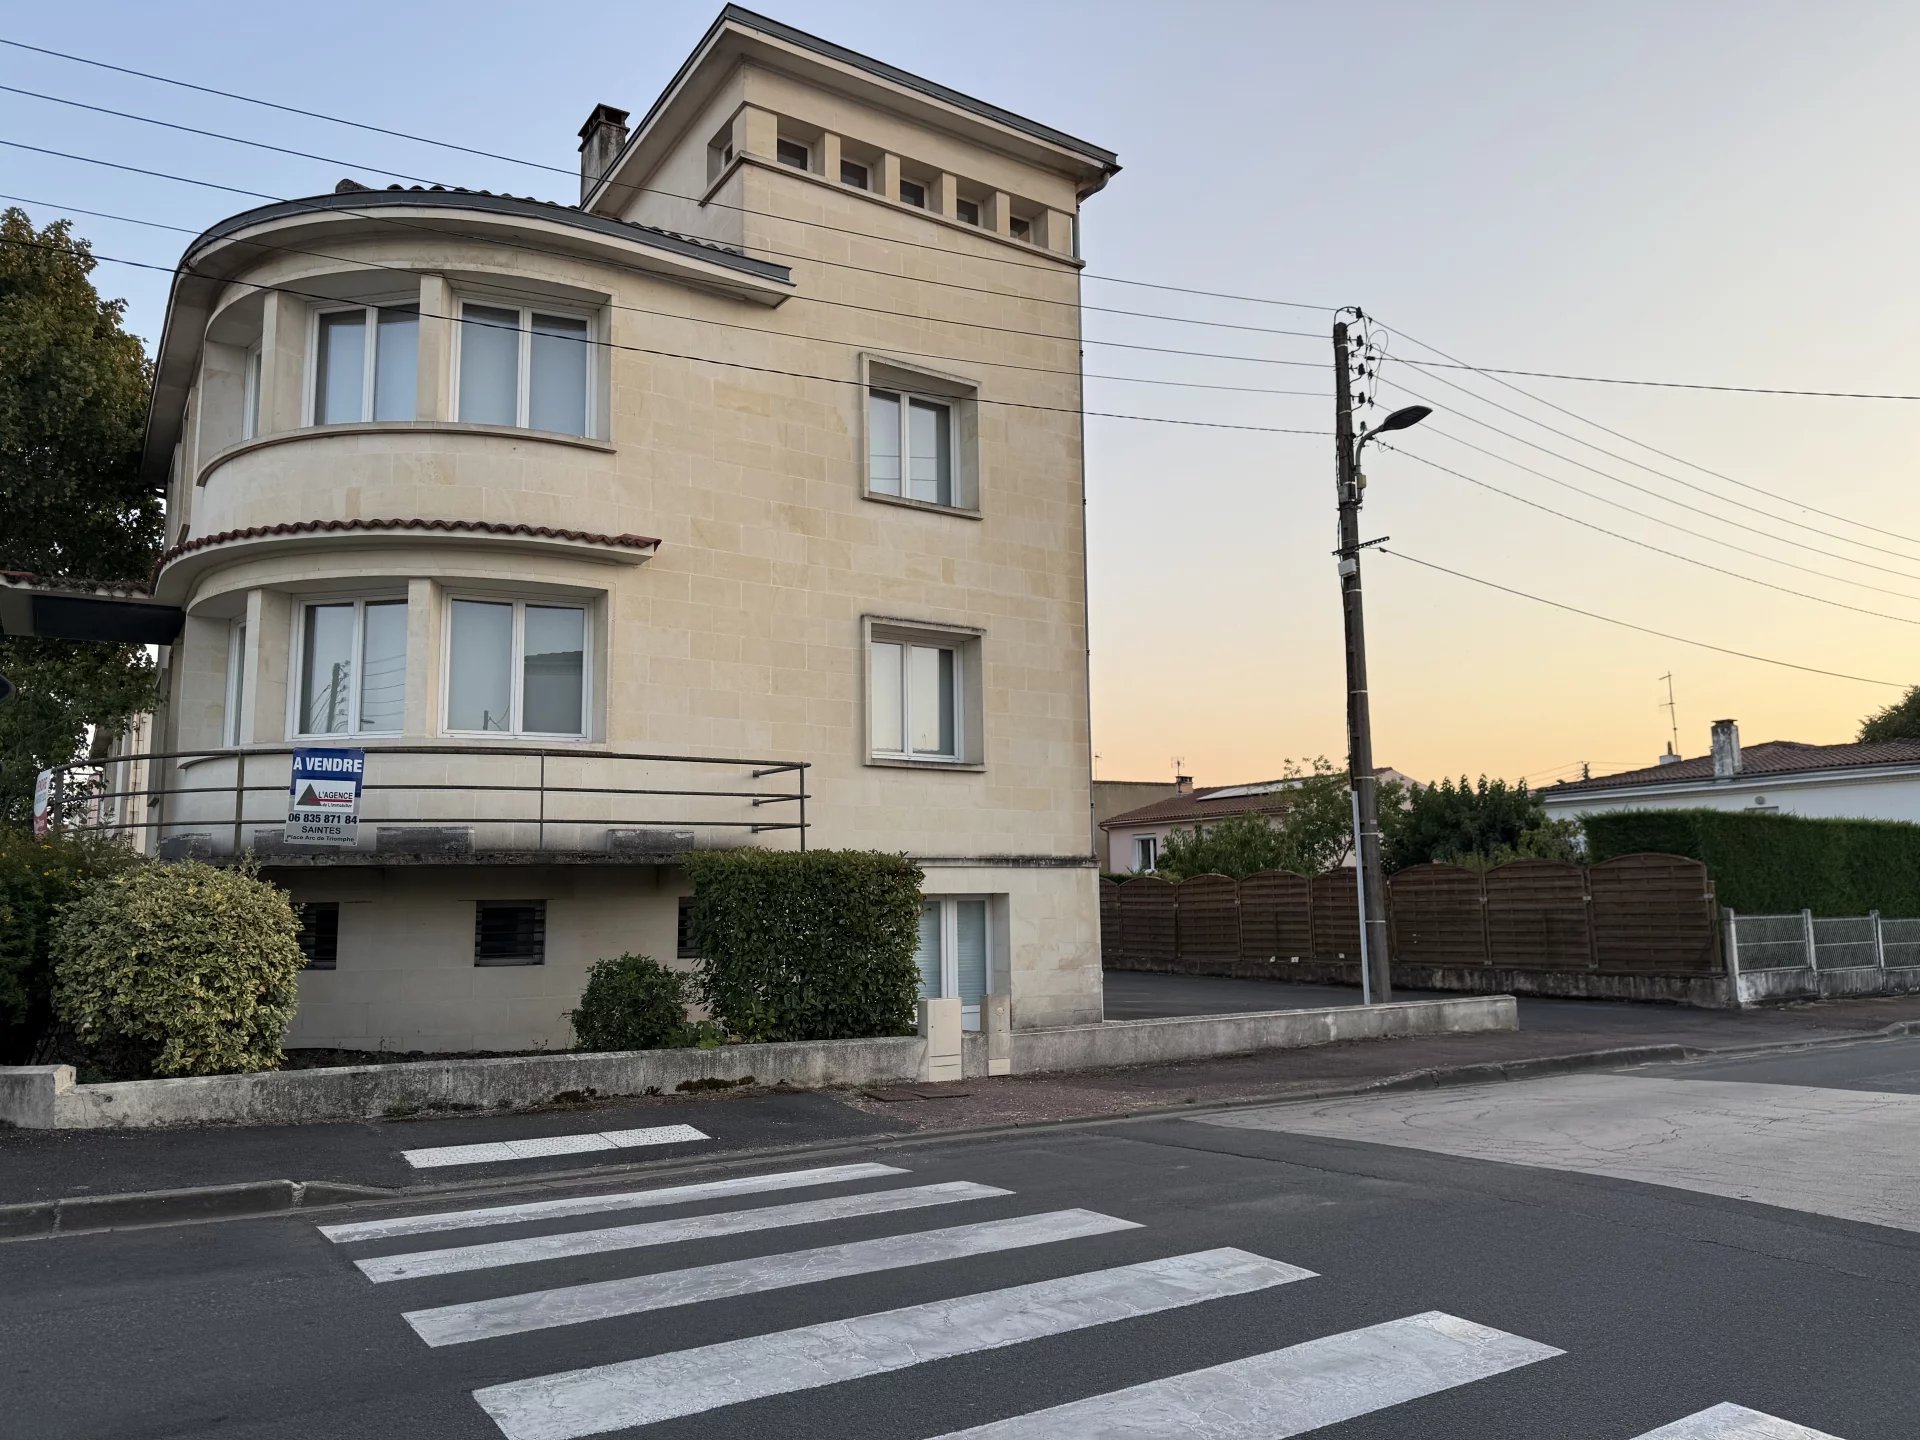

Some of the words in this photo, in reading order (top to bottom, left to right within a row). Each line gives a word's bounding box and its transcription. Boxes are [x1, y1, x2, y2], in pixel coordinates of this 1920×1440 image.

[293, 757, 302, 770] A
[306, 757, 362, 772] VENDRE
[288, 813, 300, 822] 06
[304, 814, 321, 823] 835
[324, 815, 341, 824] 871
[345, 816, 357, 825] 84
[302, 826, 341, 834] SAINTES
